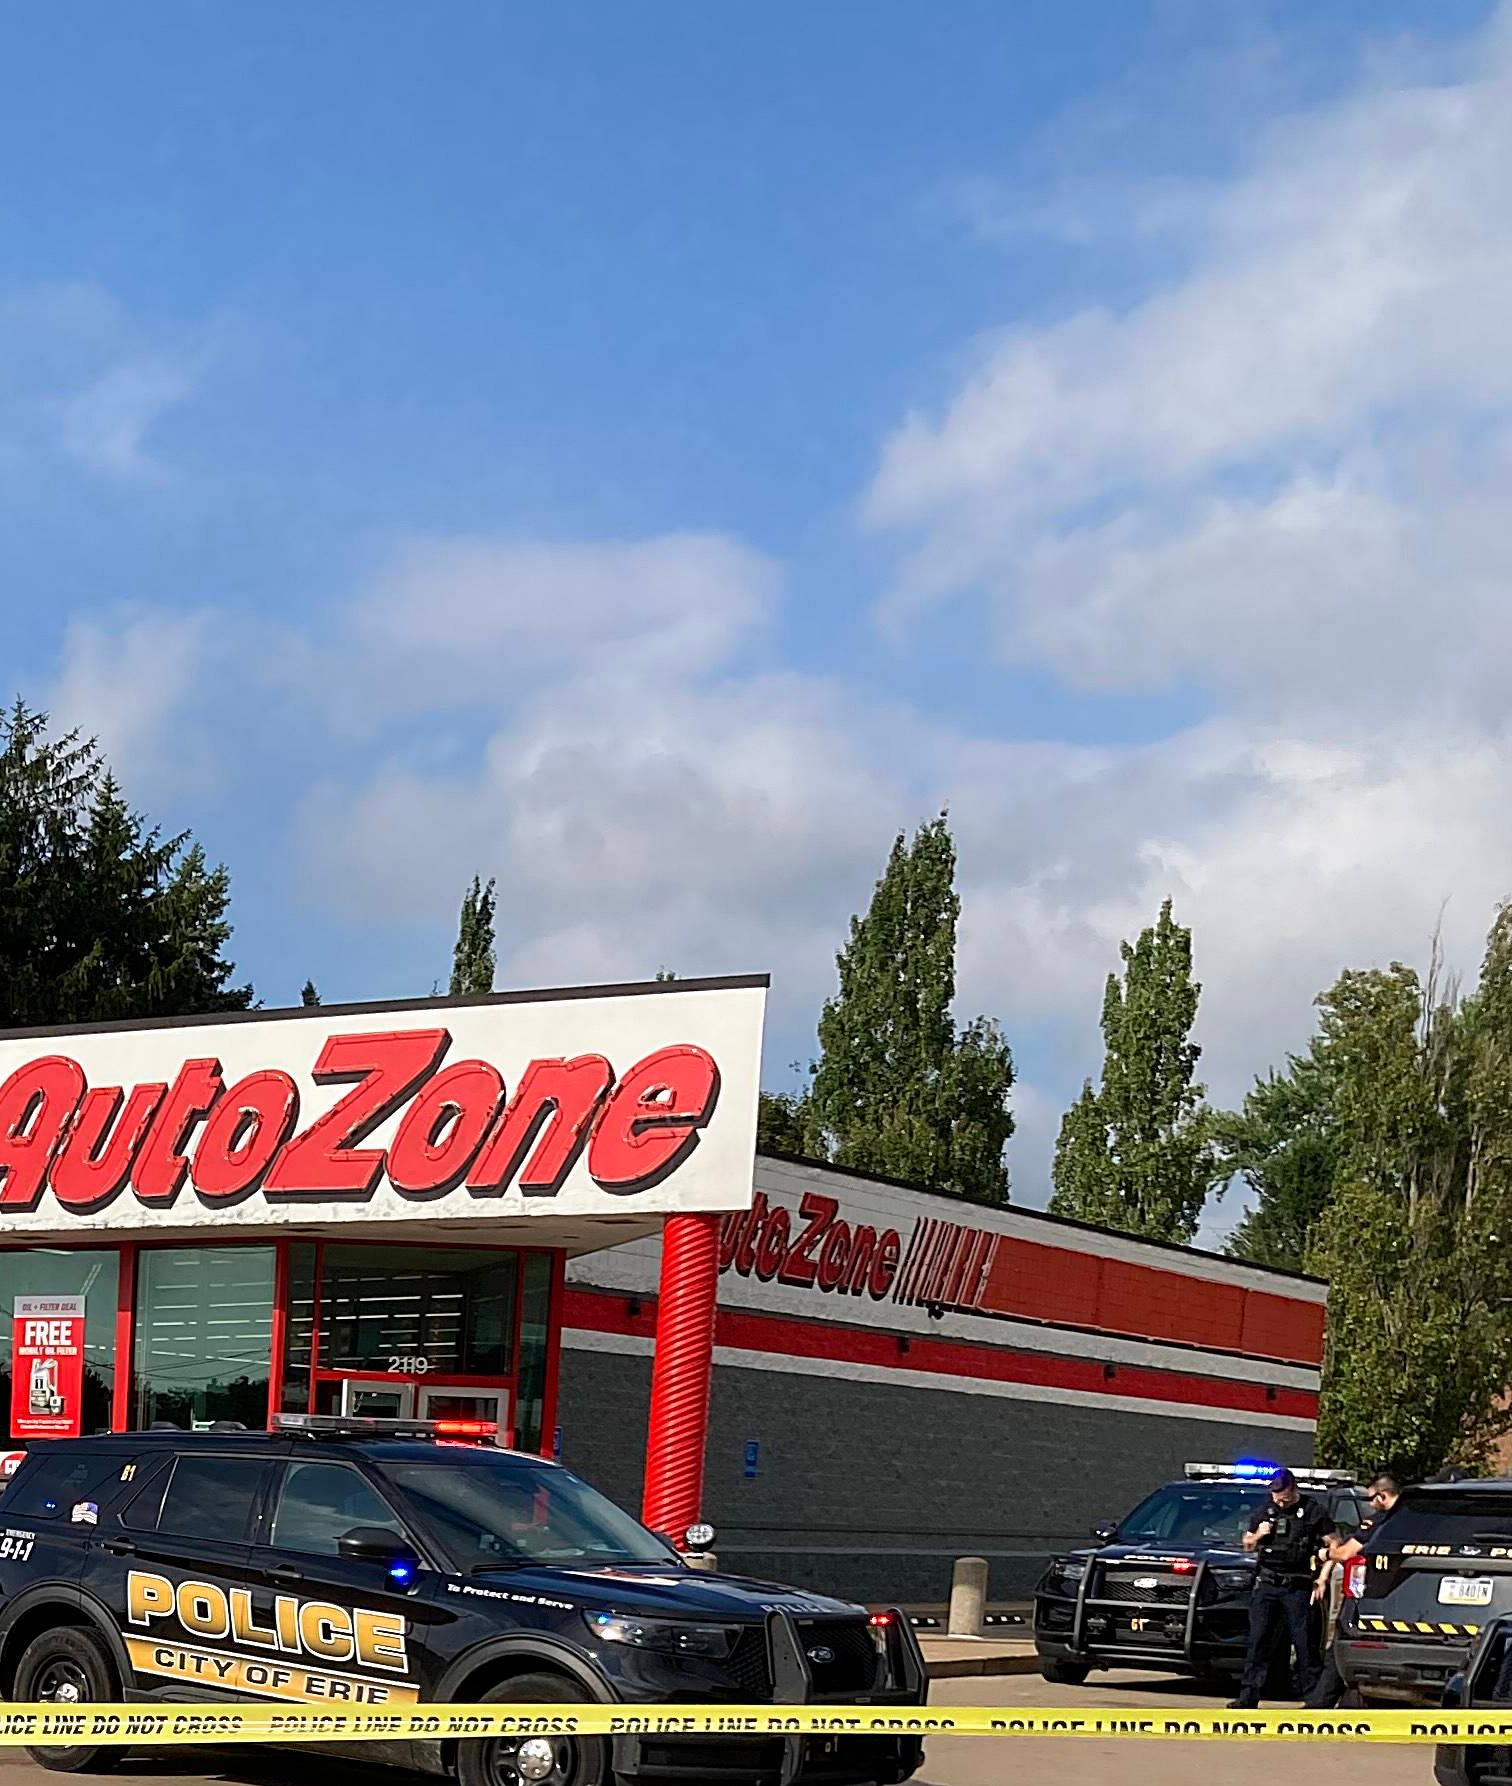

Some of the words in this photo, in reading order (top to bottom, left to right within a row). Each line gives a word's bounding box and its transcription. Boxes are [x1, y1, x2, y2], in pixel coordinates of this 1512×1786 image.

[719, 1191, 901, 1301] utoZone
[25, 1321, 73, 1345] FREE
[388, 1356, 428, 1375] 2119
[0, 1537, 34, 1562] 9-1-1
[1401, 1544, 1451, 1555] ERIE
[447, 1583, 461, 1592] To
[463, 1586, 509, 1599] Protect
[511, 1594, 536, 1603] and
[538, 1597, 574, 1610] Serve
[128, 1570, 409, 1674] POLICE
[154, 1648, 233, 1678] CITY
[246, 1665, 291, 1688] OF
[305, 1676, 390, 1704] ERIE
[42, 1715, 87, 1734] LINE
[91, 1715, 121, 1734] DO
[125, 1715, 168, 1734] NOT
[173, 1716, 243, 1733] CROSS
[270, 1716, 347, 1732] POLICE
[352, 1716, 402, 1732] LINE
[408, 1716, 440, 1732] DO
[446, 1716, 494, 1732] NOT
[500, 1716, 578, 1732] CROSS
